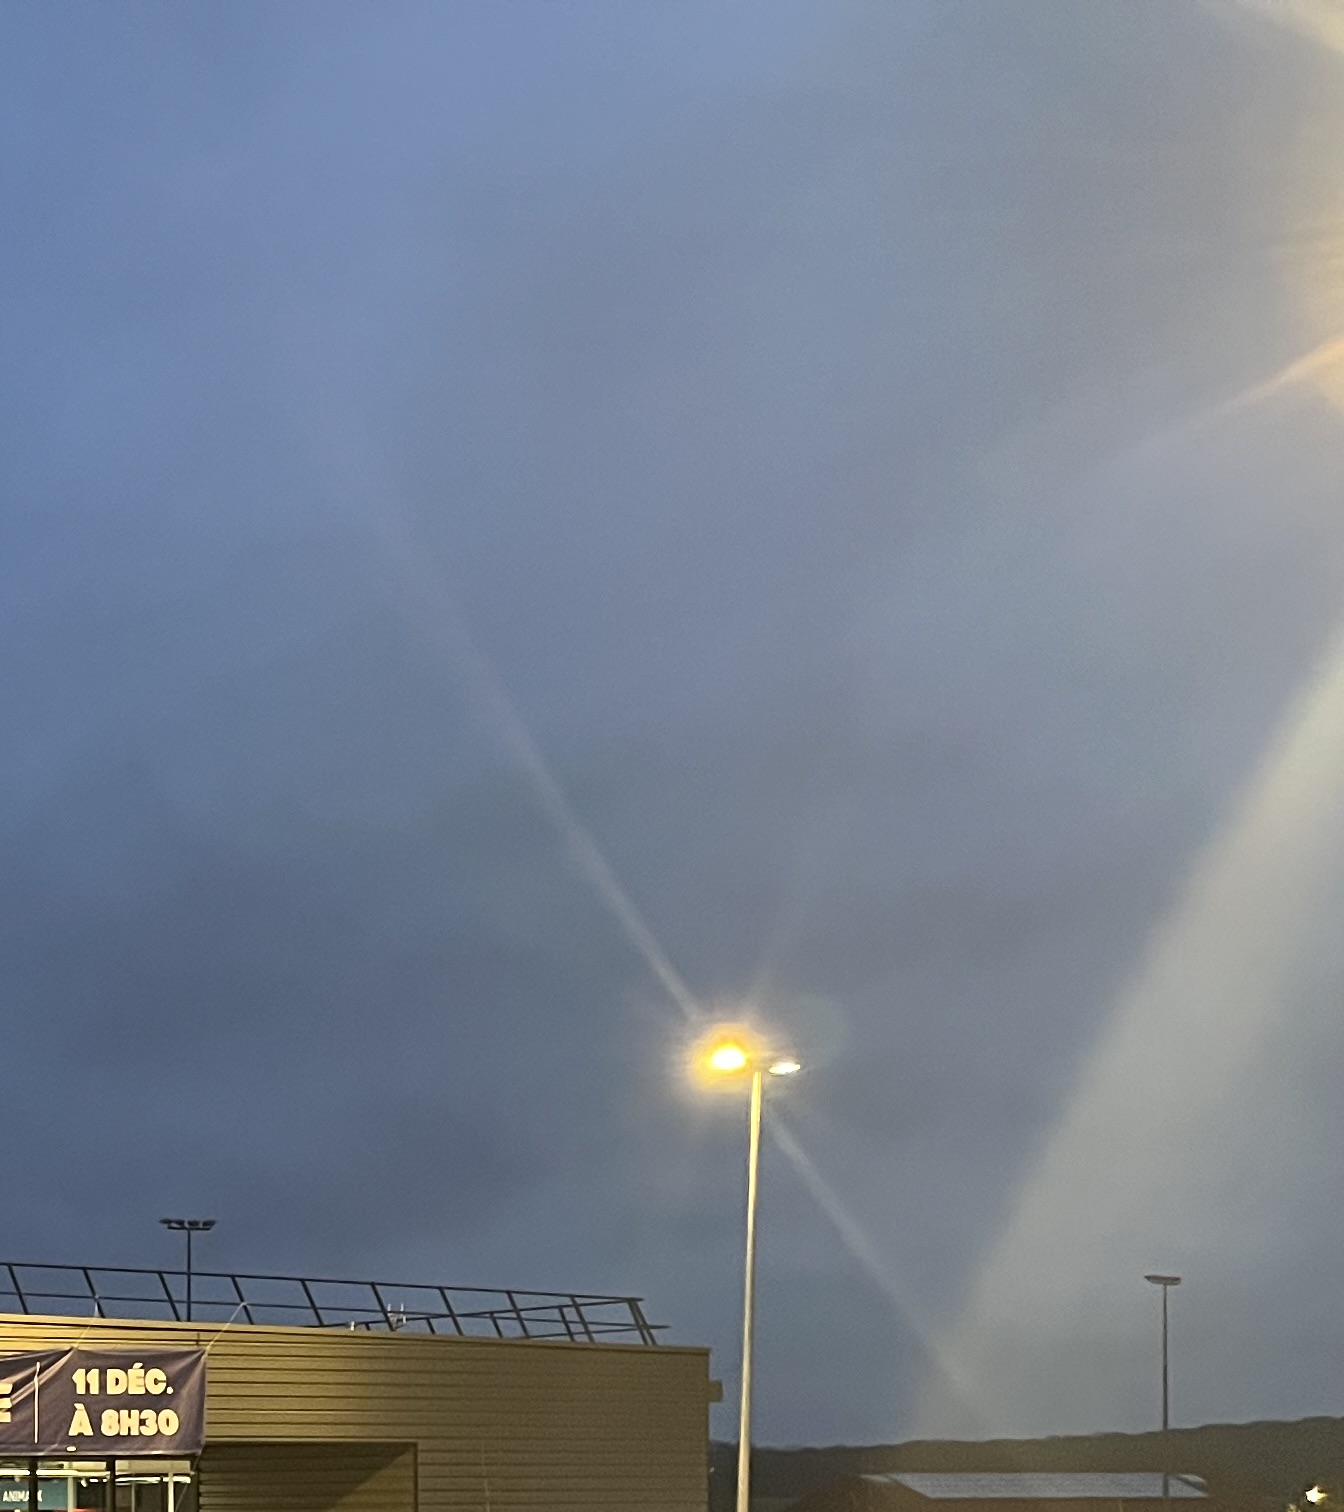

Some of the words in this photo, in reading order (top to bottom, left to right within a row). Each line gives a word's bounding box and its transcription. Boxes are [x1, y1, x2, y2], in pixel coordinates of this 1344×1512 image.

[71, 1368, 100, 1395] 11
[106, 1362, 174, 1395] DÉC.
[68, 1402, 94, 1436] À
[100, 1408, 180, 1437] 8H30
